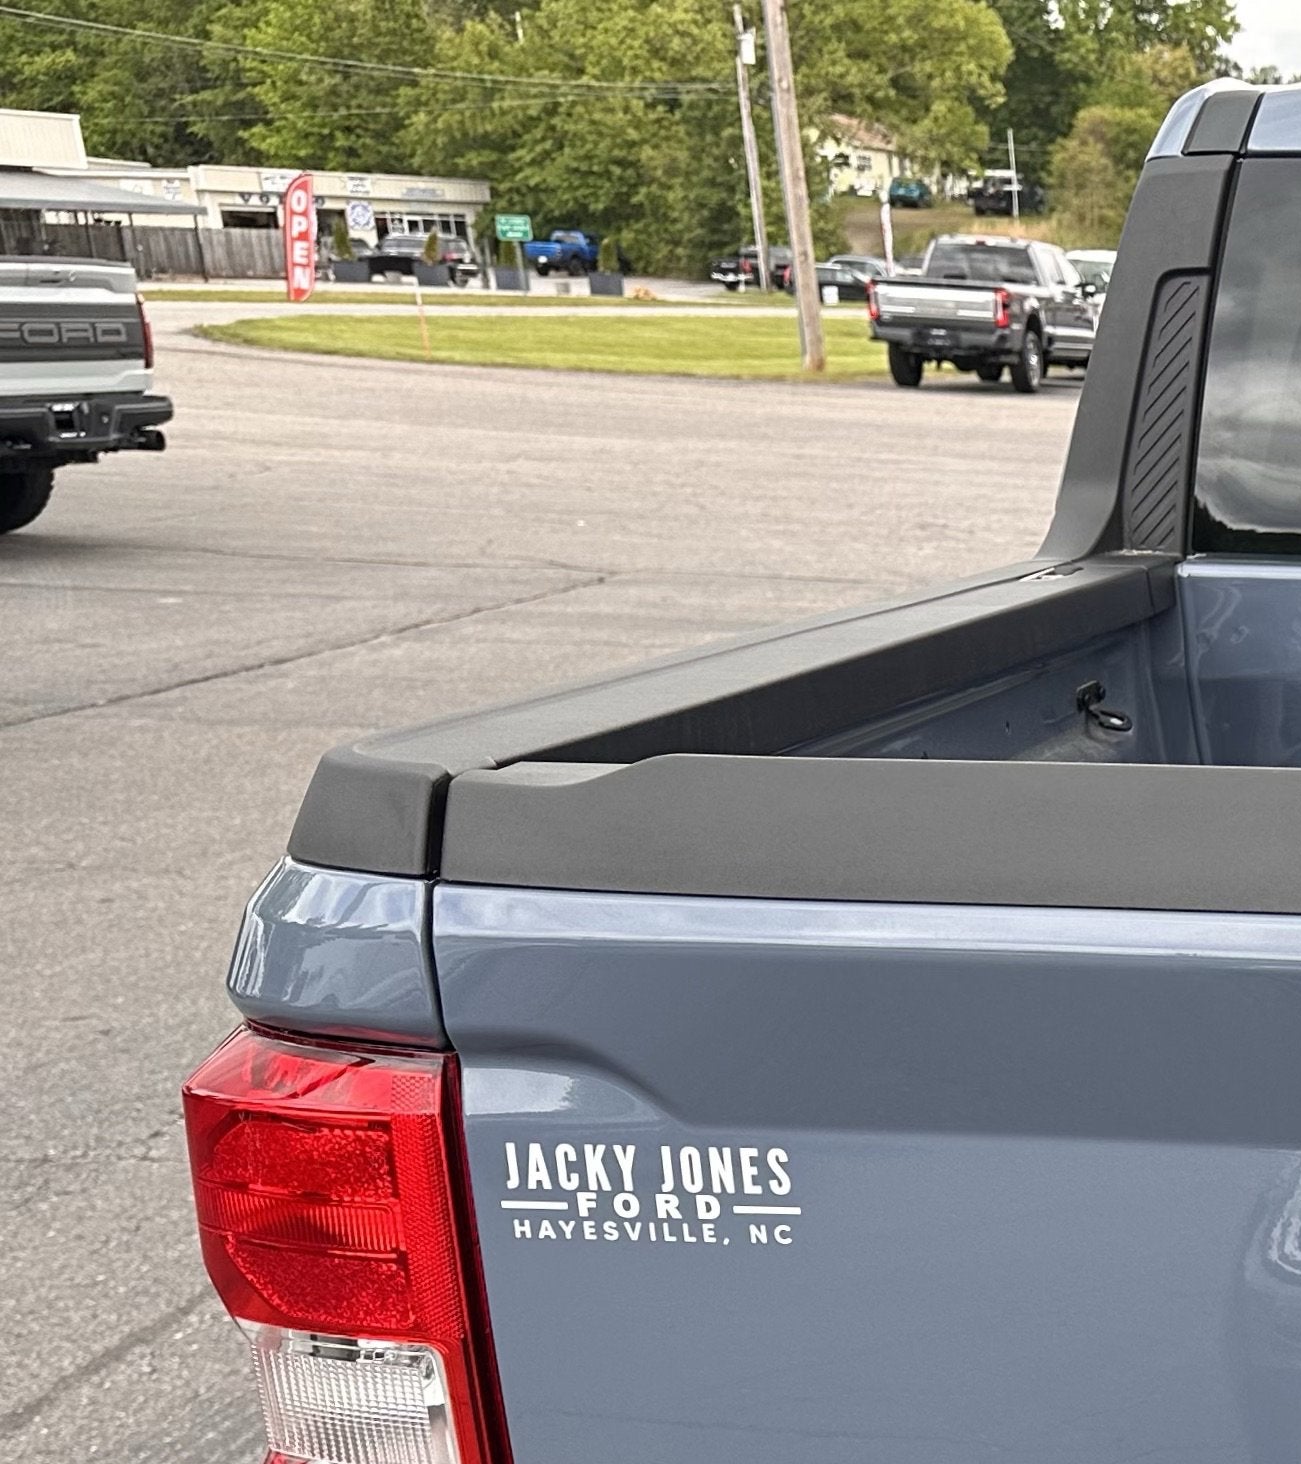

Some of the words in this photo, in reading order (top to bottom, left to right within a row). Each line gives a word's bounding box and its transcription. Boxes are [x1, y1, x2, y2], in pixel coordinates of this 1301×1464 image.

[290, 189, 311, 290] OPEN
[505, 1142, 636, 1192] JACKY
[661, 1145, 792, 1195] JONES
[577, 1191, 721, 1220] FORD
[513, 1218, 731, 1246] HAYESVILLE,
[749, 1224, 793, 1245] NC
